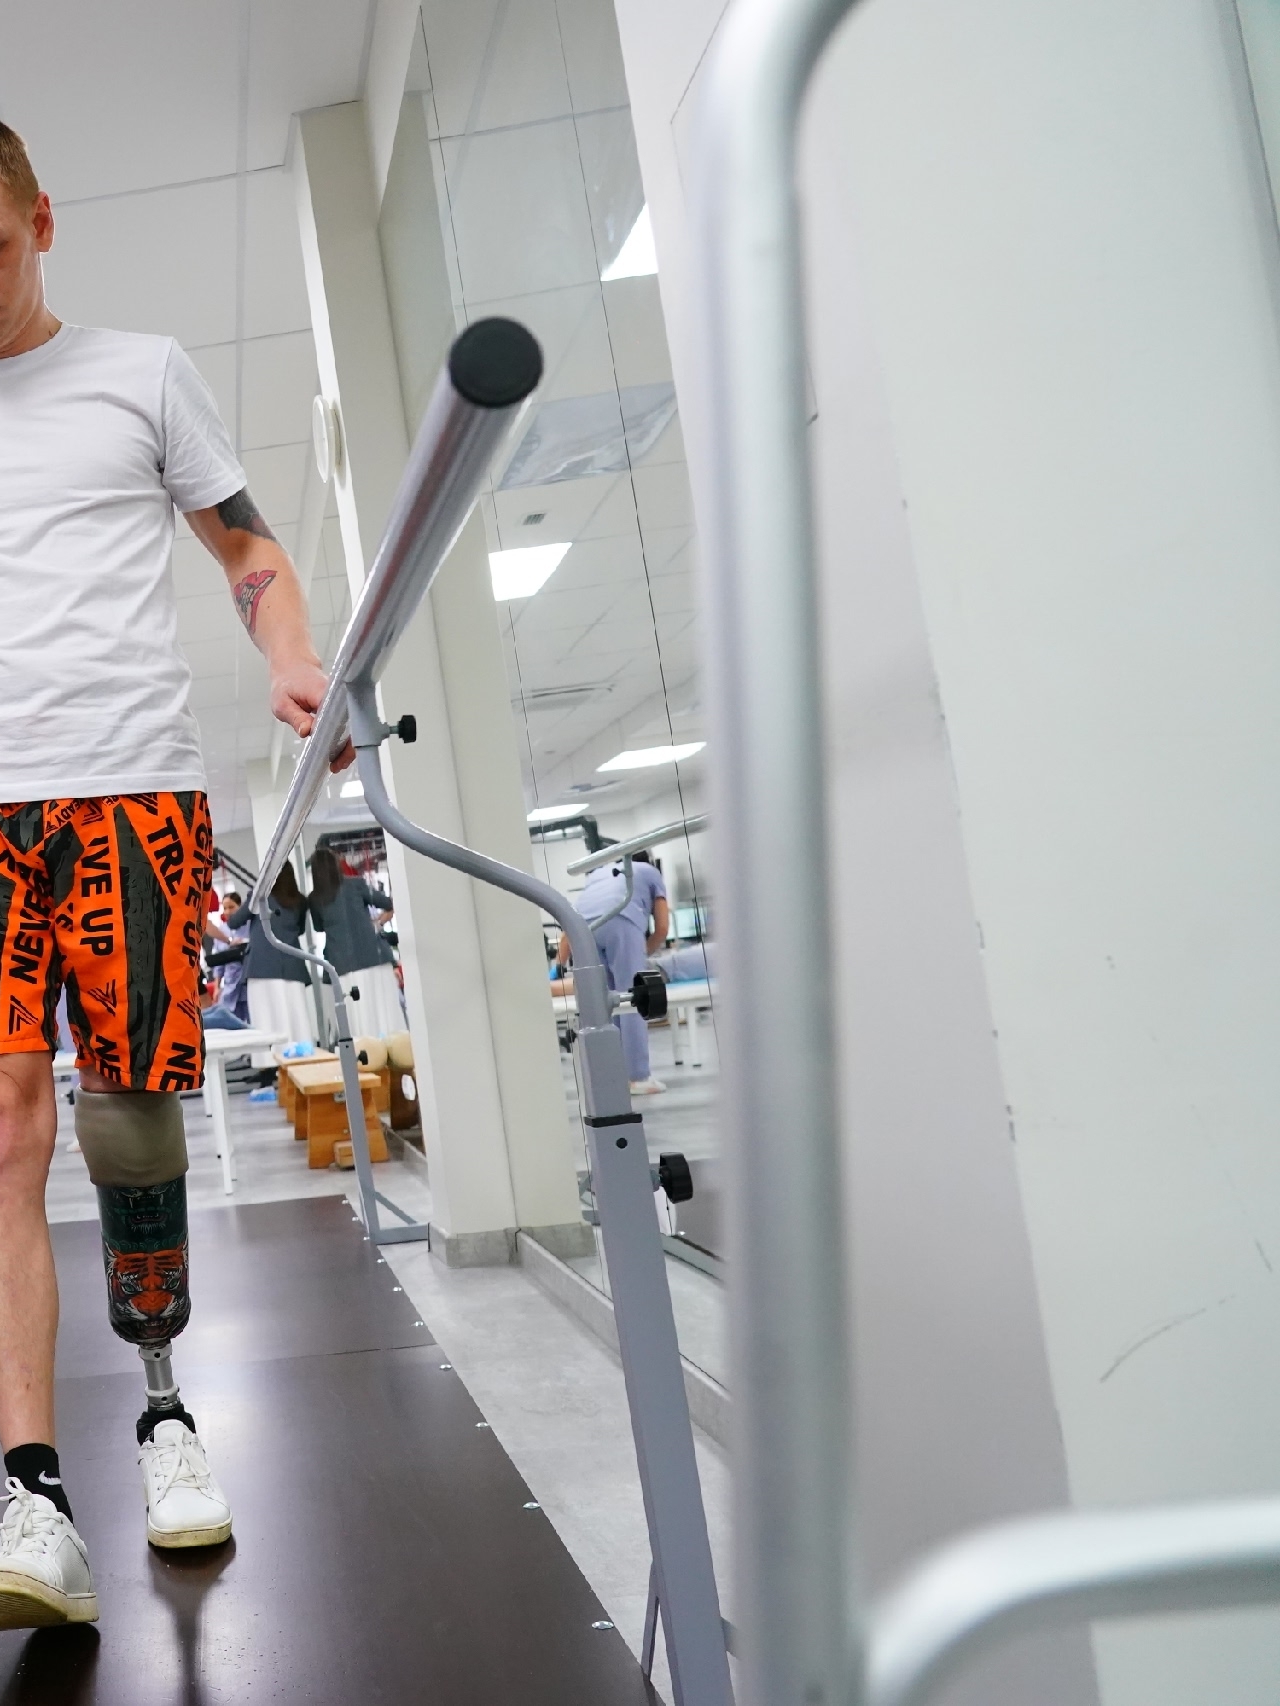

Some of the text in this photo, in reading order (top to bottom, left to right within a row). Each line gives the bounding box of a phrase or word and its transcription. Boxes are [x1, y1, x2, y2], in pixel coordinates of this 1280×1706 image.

[185, 822, 209, 910] GIVE
[79, 907, 113, 956] UP
[182, 921, 198, 969] UP
